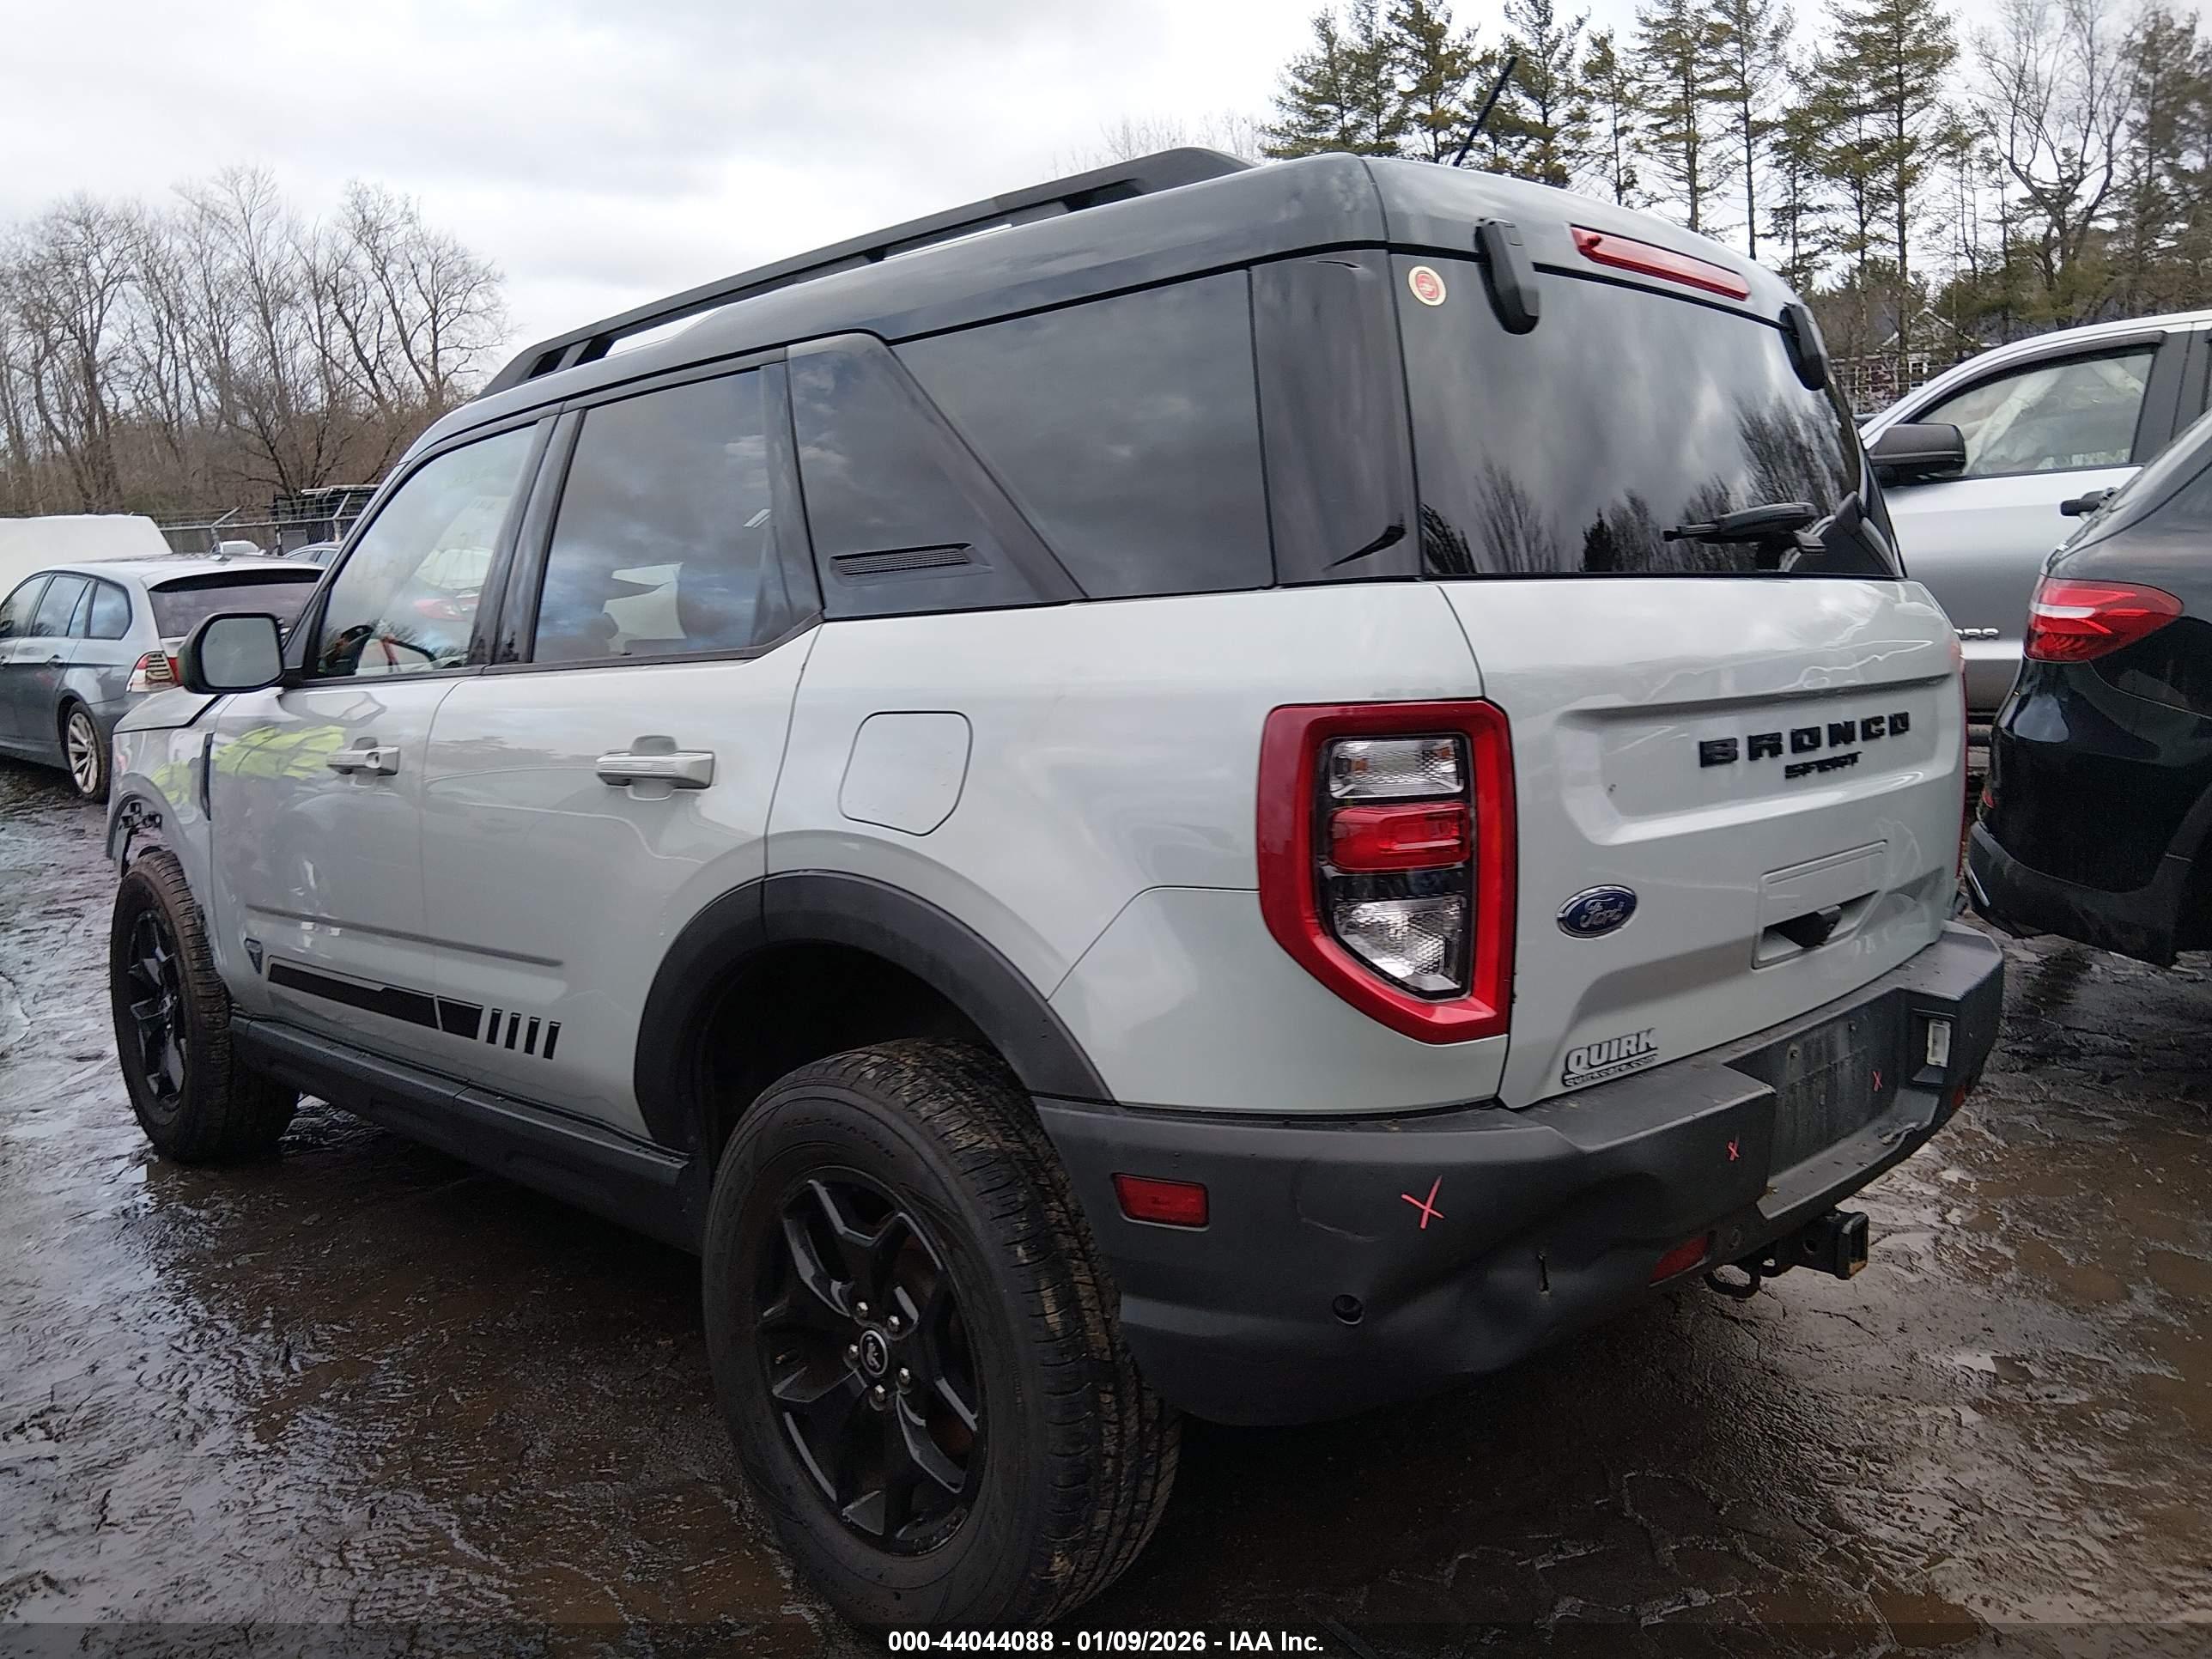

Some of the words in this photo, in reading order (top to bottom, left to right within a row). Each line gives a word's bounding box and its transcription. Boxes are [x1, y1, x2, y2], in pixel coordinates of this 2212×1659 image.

[1699, 712, 1910, 768] BRONCO
[1784, 750, 1863, 780] SPORT
[1580, 897, 1625, 928] Ford
[1565, 1027, 1658, 1075] QUIRK
